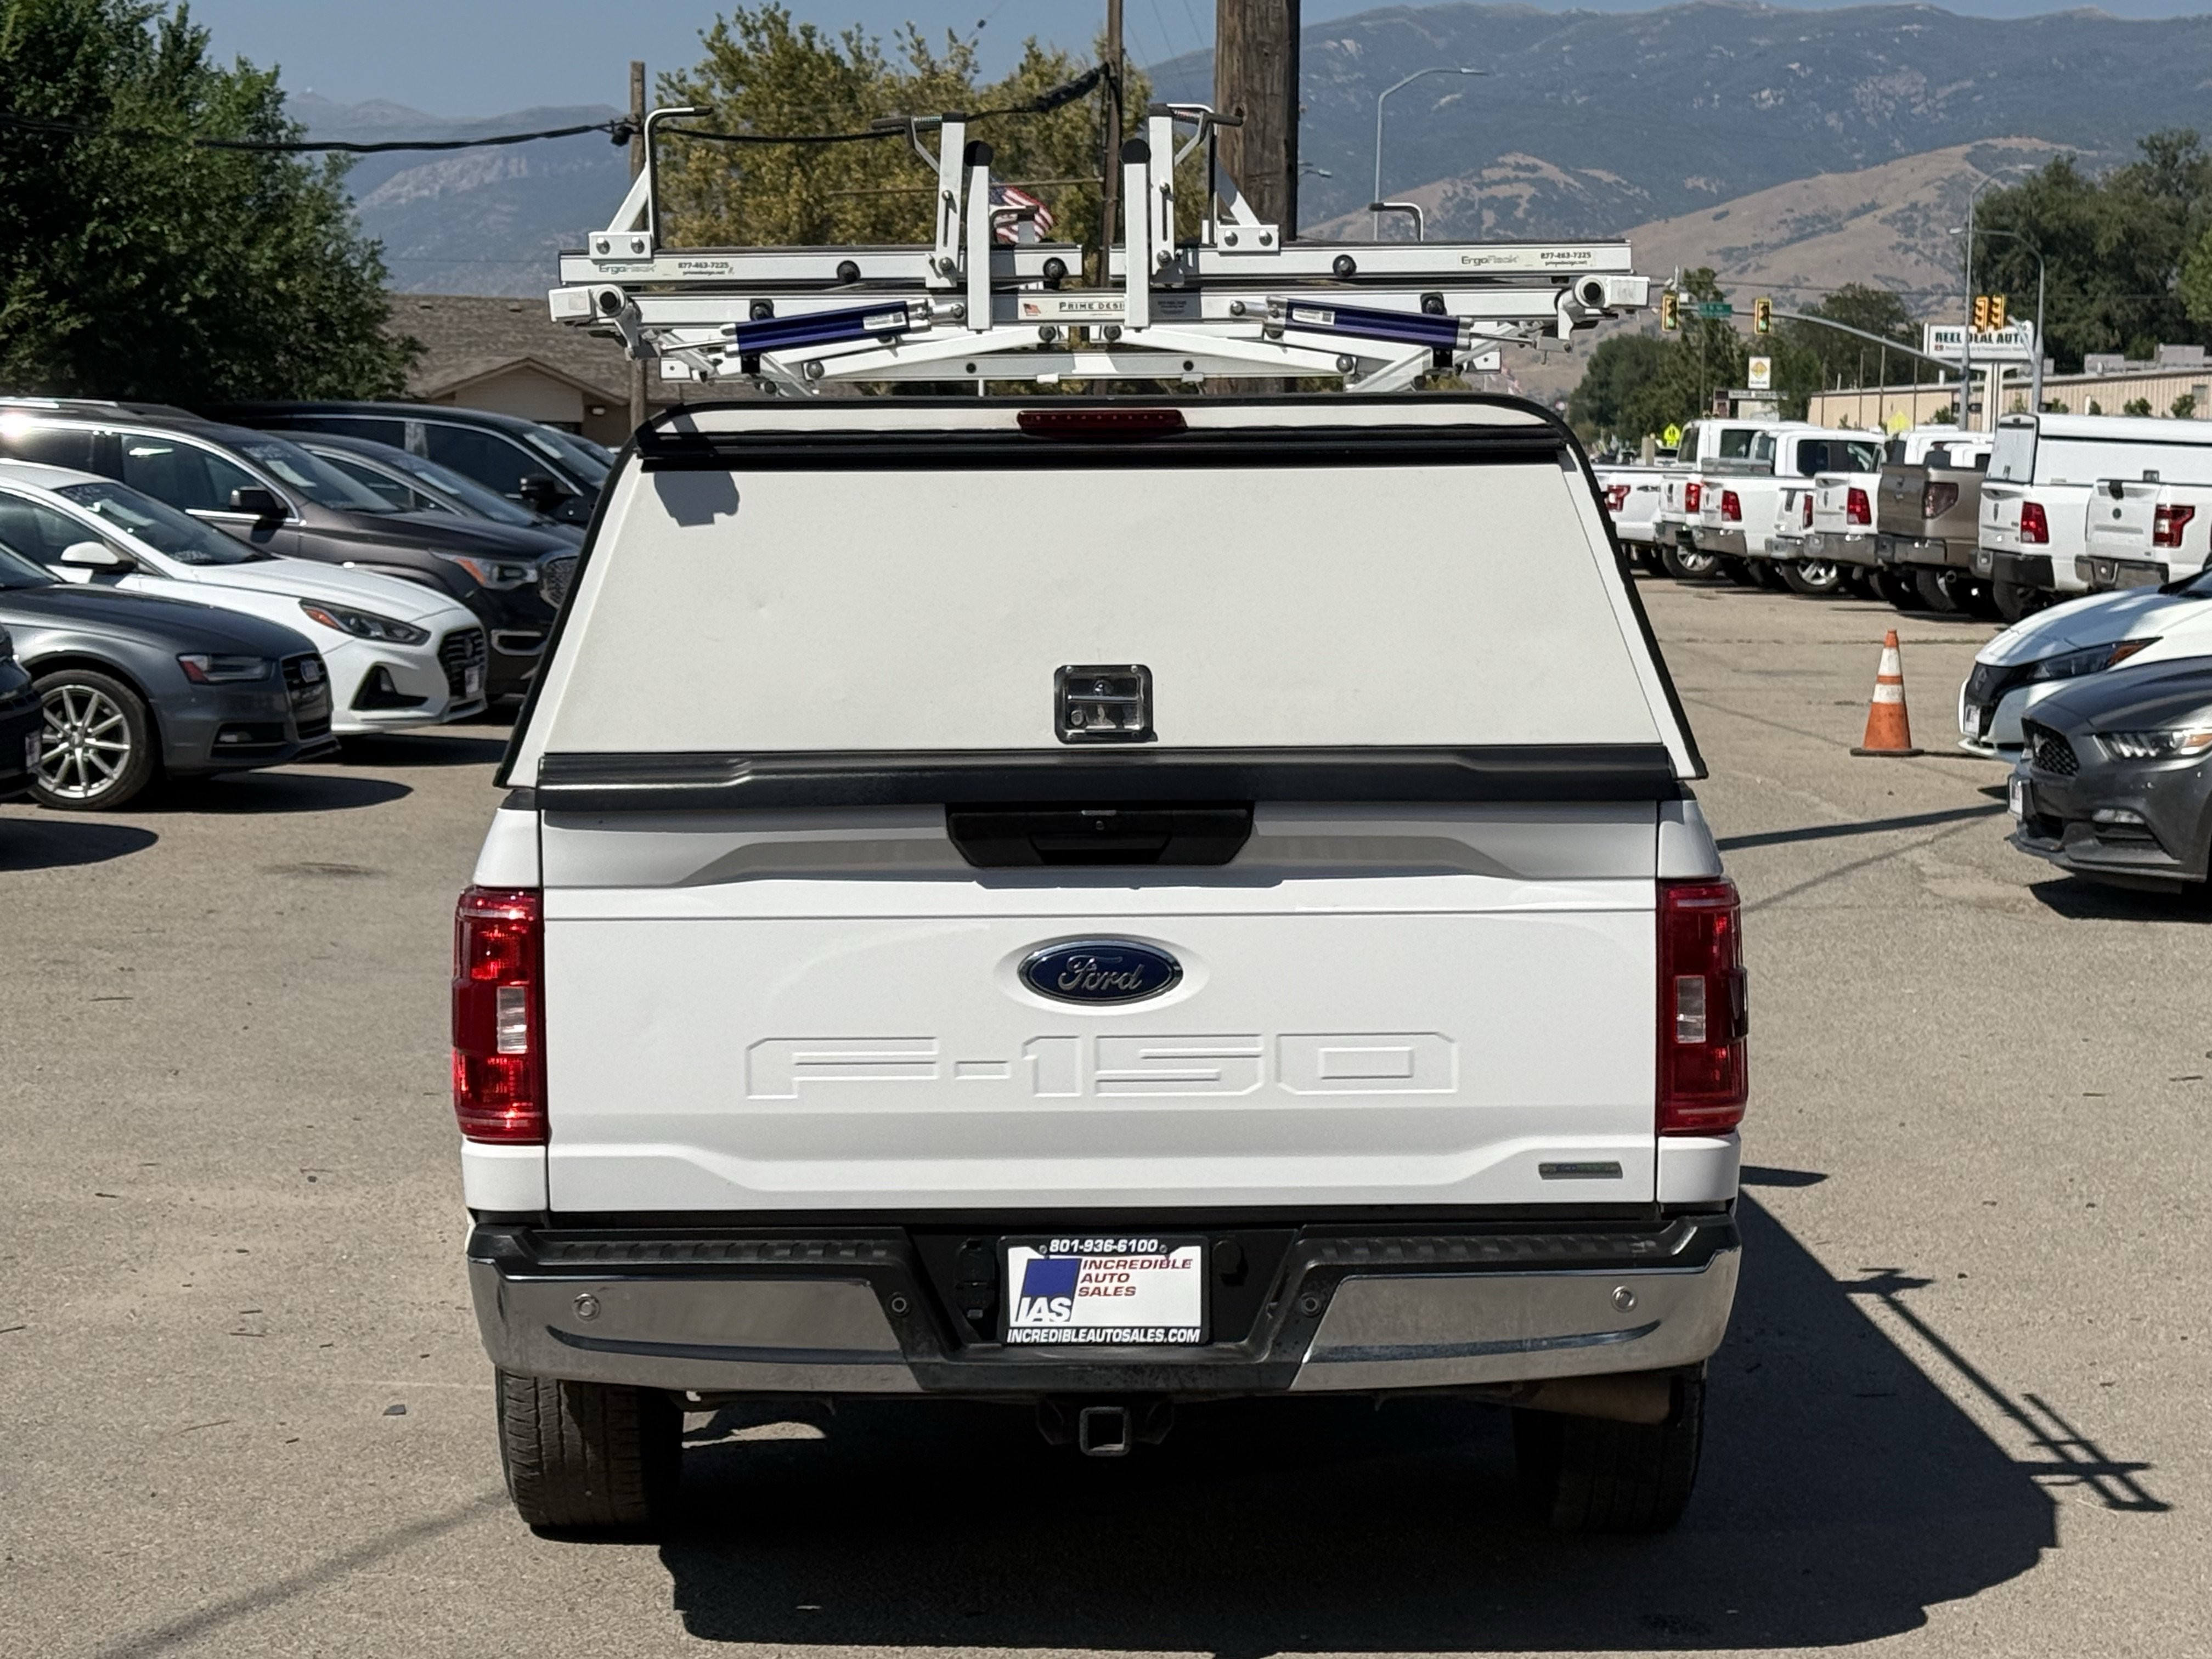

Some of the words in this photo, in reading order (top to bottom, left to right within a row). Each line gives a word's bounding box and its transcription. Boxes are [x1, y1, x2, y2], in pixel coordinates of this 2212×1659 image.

[1059, 301, 1094, 310] PRIME
[1098, 301, 1125, 310] DESI
[1058, 954, 1145, 991] Ford
[746, 1032, 1458, 1099] F-150
[1049, 1239, 1159, 1253] 801-936-6100
[1082, 1259, 1193, 1269] INCREDIBLE
[1080, 1273, 1130, 1283] AUTO
[1077, 1286, 1137, 1296] SALES
[1019, 1297, 1072, 1322] IAS
[1007, 1328, 1200, 1343] INCREDIBLEAUTOSALES.COM
